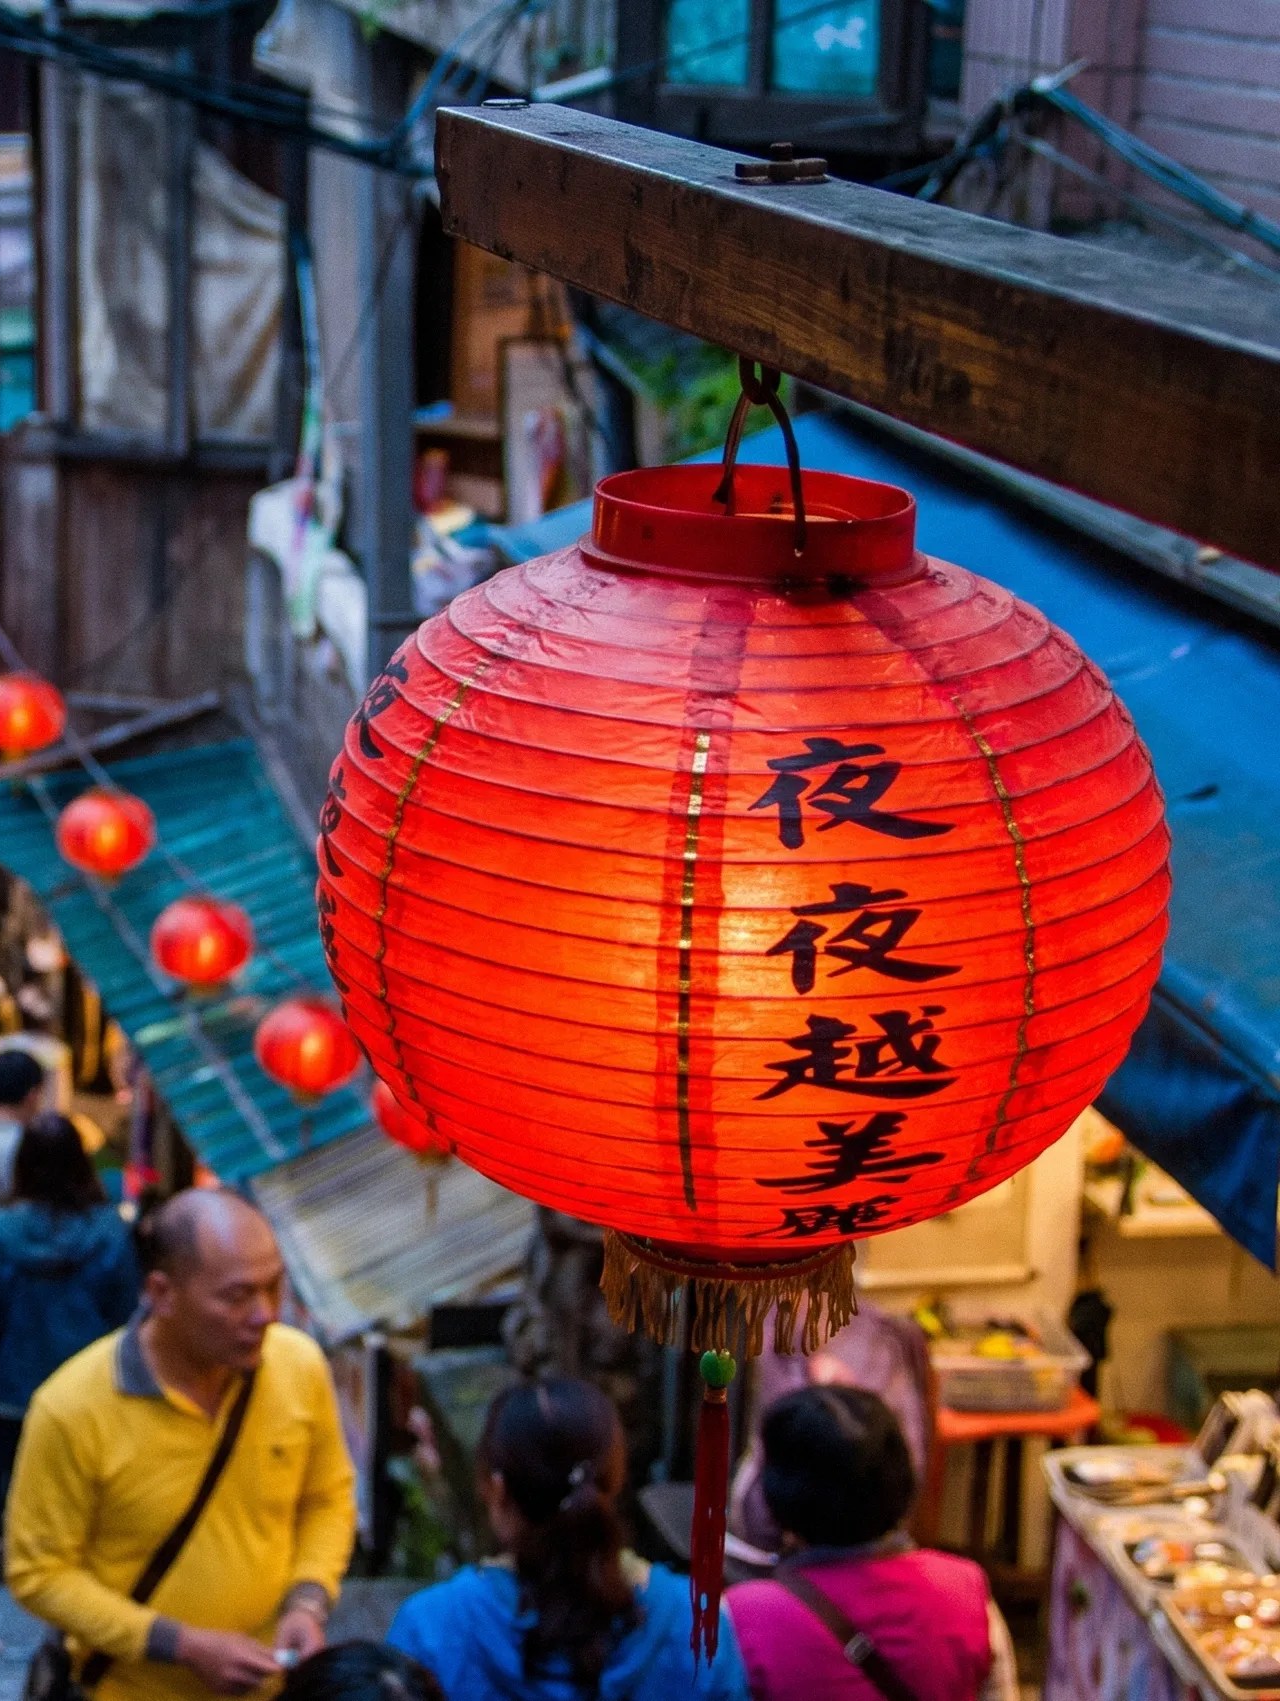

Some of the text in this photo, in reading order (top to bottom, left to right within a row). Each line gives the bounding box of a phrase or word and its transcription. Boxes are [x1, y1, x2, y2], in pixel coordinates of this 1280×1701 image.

[747, 737, 963, 1240] 夜夜越美麗
